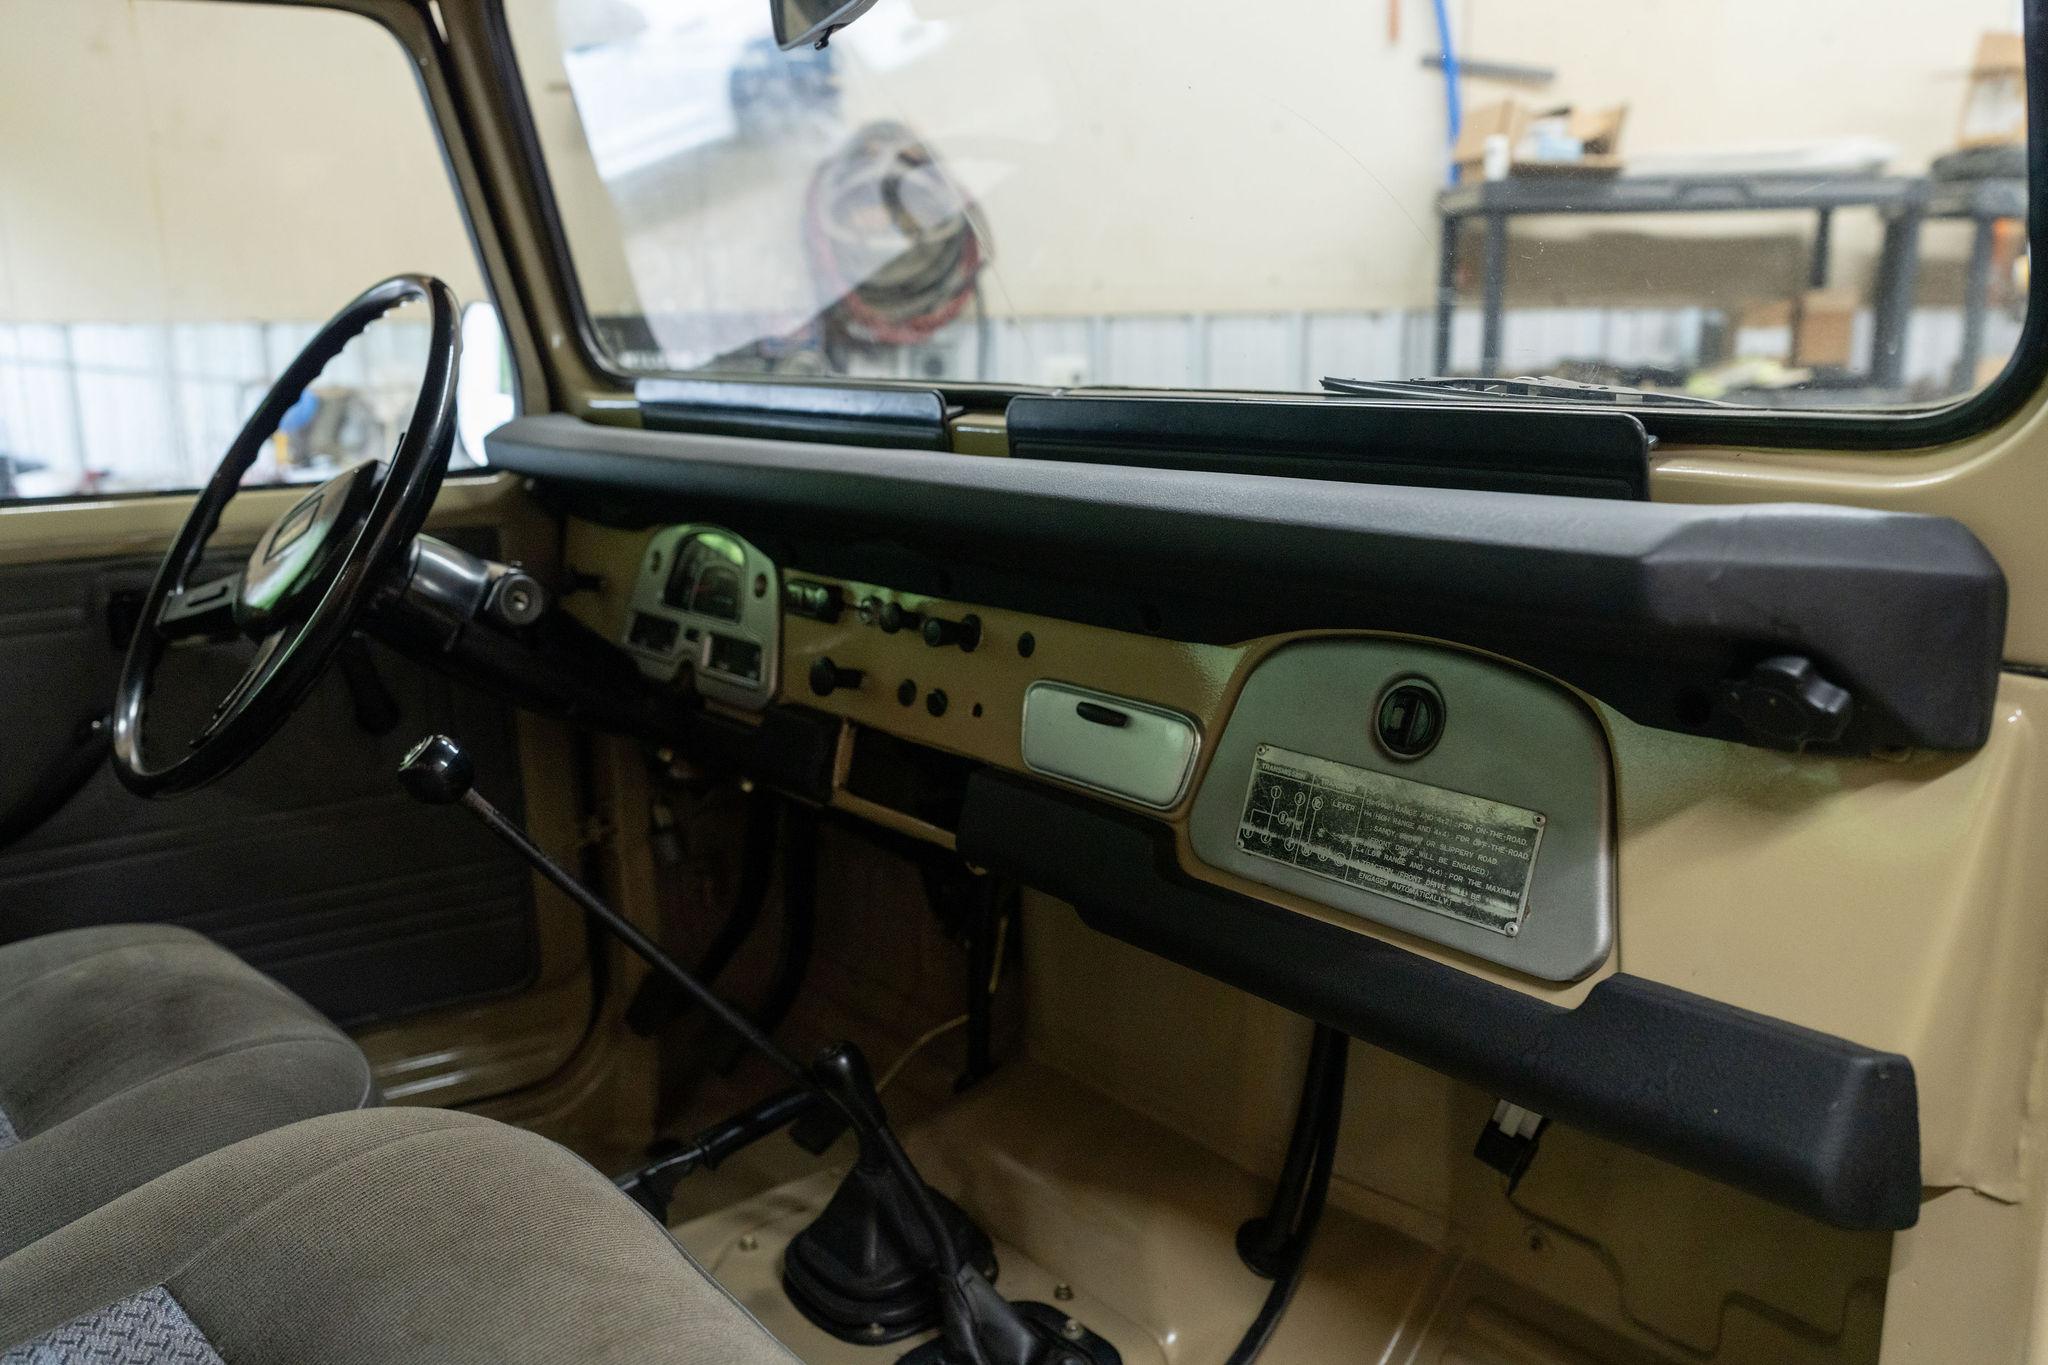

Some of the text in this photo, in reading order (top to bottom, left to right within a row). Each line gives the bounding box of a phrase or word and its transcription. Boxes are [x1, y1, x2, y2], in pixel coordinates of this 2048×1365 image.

[1332, 800, 1355, 812] LEVER
[1392, 817, 1415, 829] RANGE
[1416, 823, 1431, 833] AND
[1454, 833, 1470, 844] FOR
[1457, 821, 1473, 831] FOR
[1394, 843, 1415, 855] DRIVE
[1417, 850, 1435, 861] WILL
[1438, 856, 1448, 864] BE
[1425, 839, 1436, 848] OR
[1439, 843, 1474, 859] SLIPPERY
[1383, 853, 1406, 865] RANGE
[1409, 860, 1423, 871] AND
[1448, 872, 1463, 882] FOR
[1466, 877, 1482, 888] THE
[1485, 882, 1520, 899] MAXIMUM
[1425, 878, 1446, 891] DRIVE
[1470, 892, 1480, 901] BE
